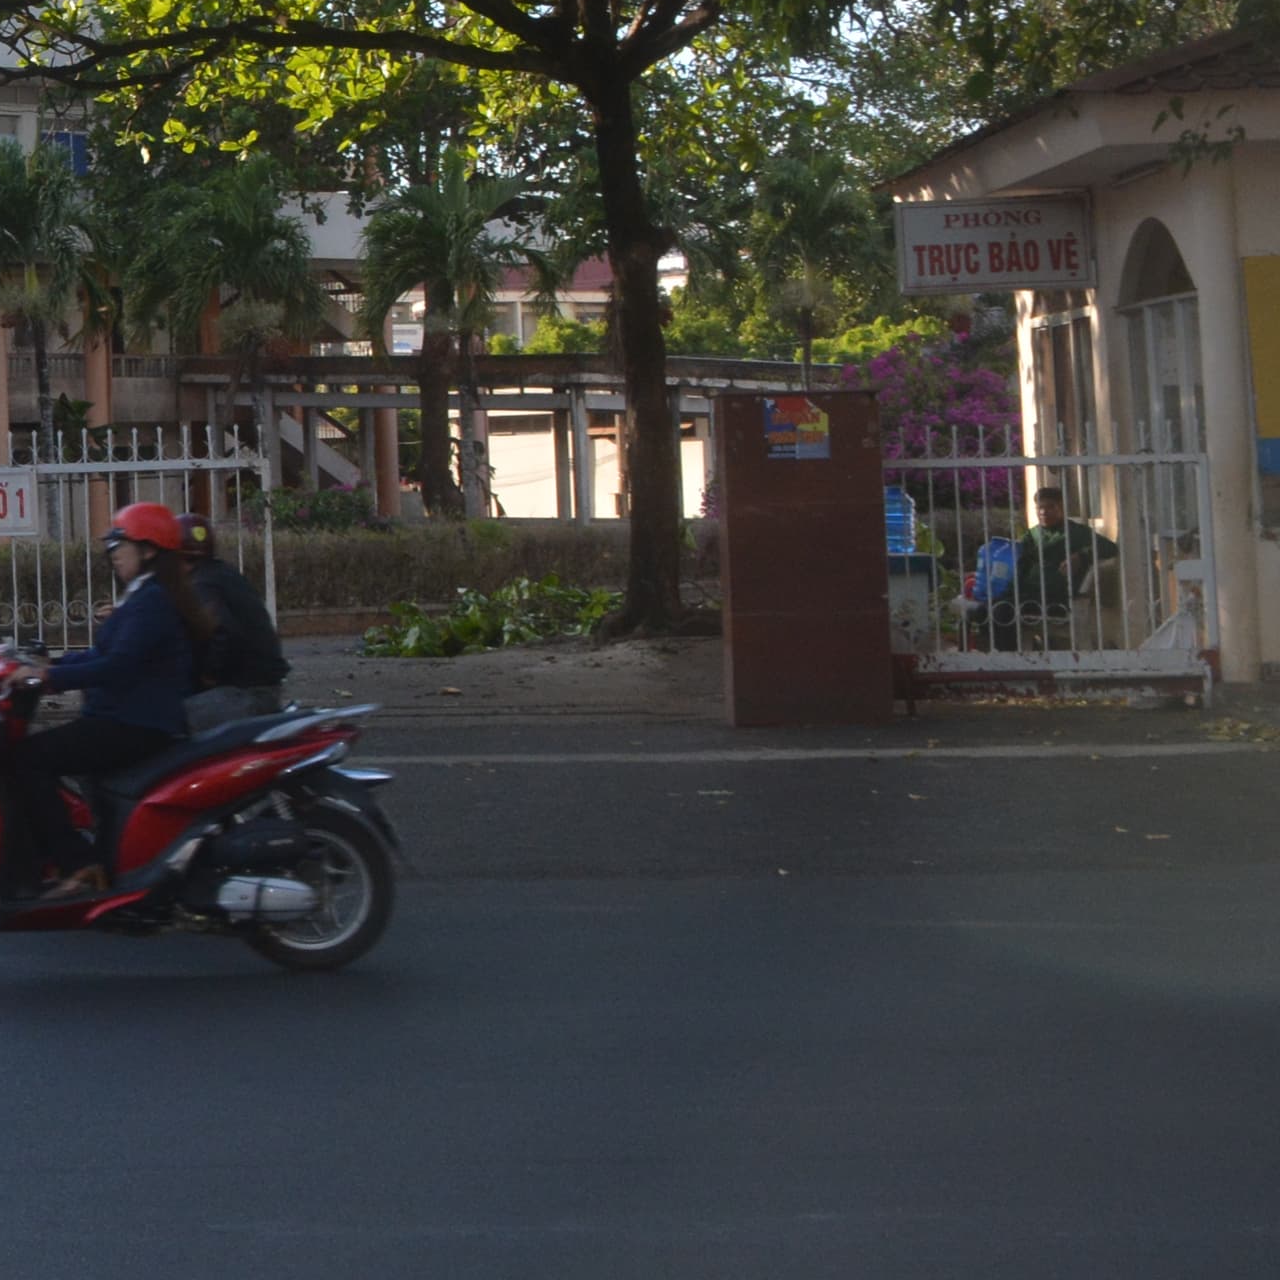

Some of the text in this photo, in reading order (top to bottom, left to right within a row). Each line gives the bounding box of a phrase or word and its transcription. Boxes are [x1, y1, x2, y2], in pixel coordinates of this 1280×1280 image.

[913, 231, 1080, 282] TRỰC BẢO VỆ
[15, 487, 25, 519] 1
